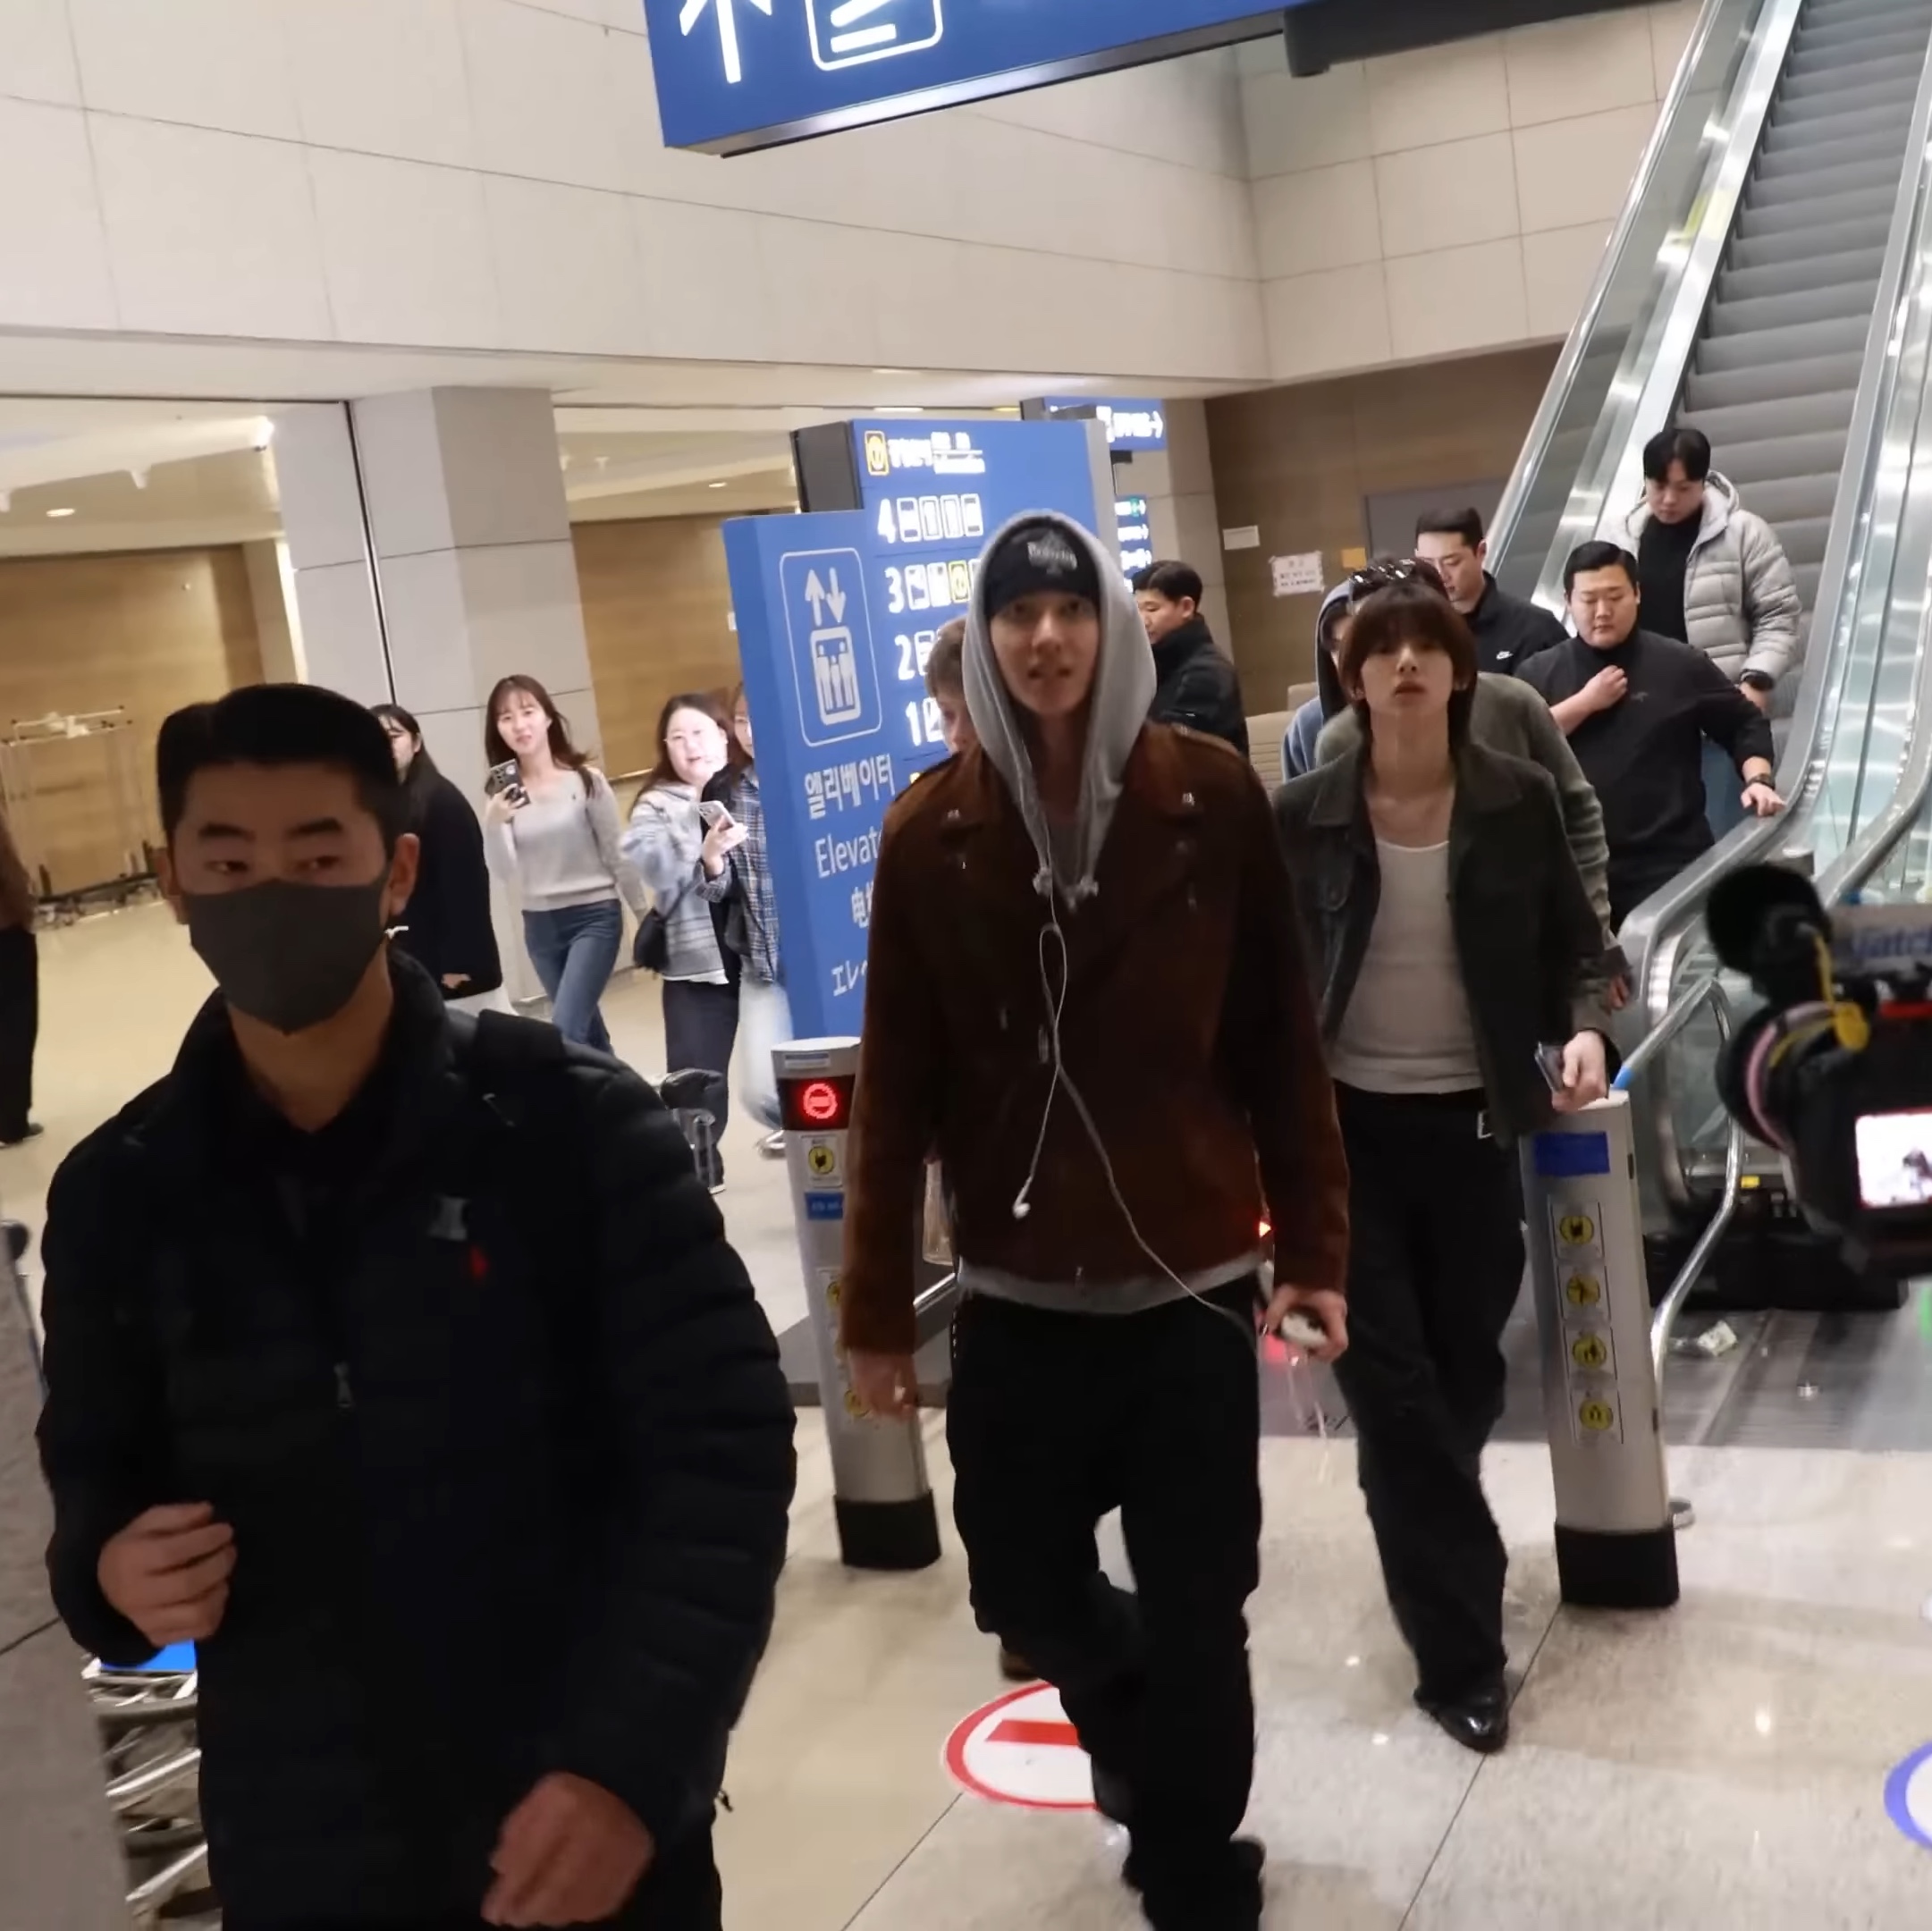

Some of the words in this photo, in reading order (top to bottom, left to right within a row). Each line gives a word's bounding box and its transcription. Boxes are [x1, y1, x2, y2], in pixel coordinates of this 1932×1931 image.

[878, 499, 895, 543] 4
[885, 567, 904, 612] 3
[895, 635, 915, 680] 2
[906, 702, 921, 746] 1
[806, 754, 895, 819] 엘리베이터
[815, 823, 882, 877] Elevat
[831, 959, 868, 997] エレ
